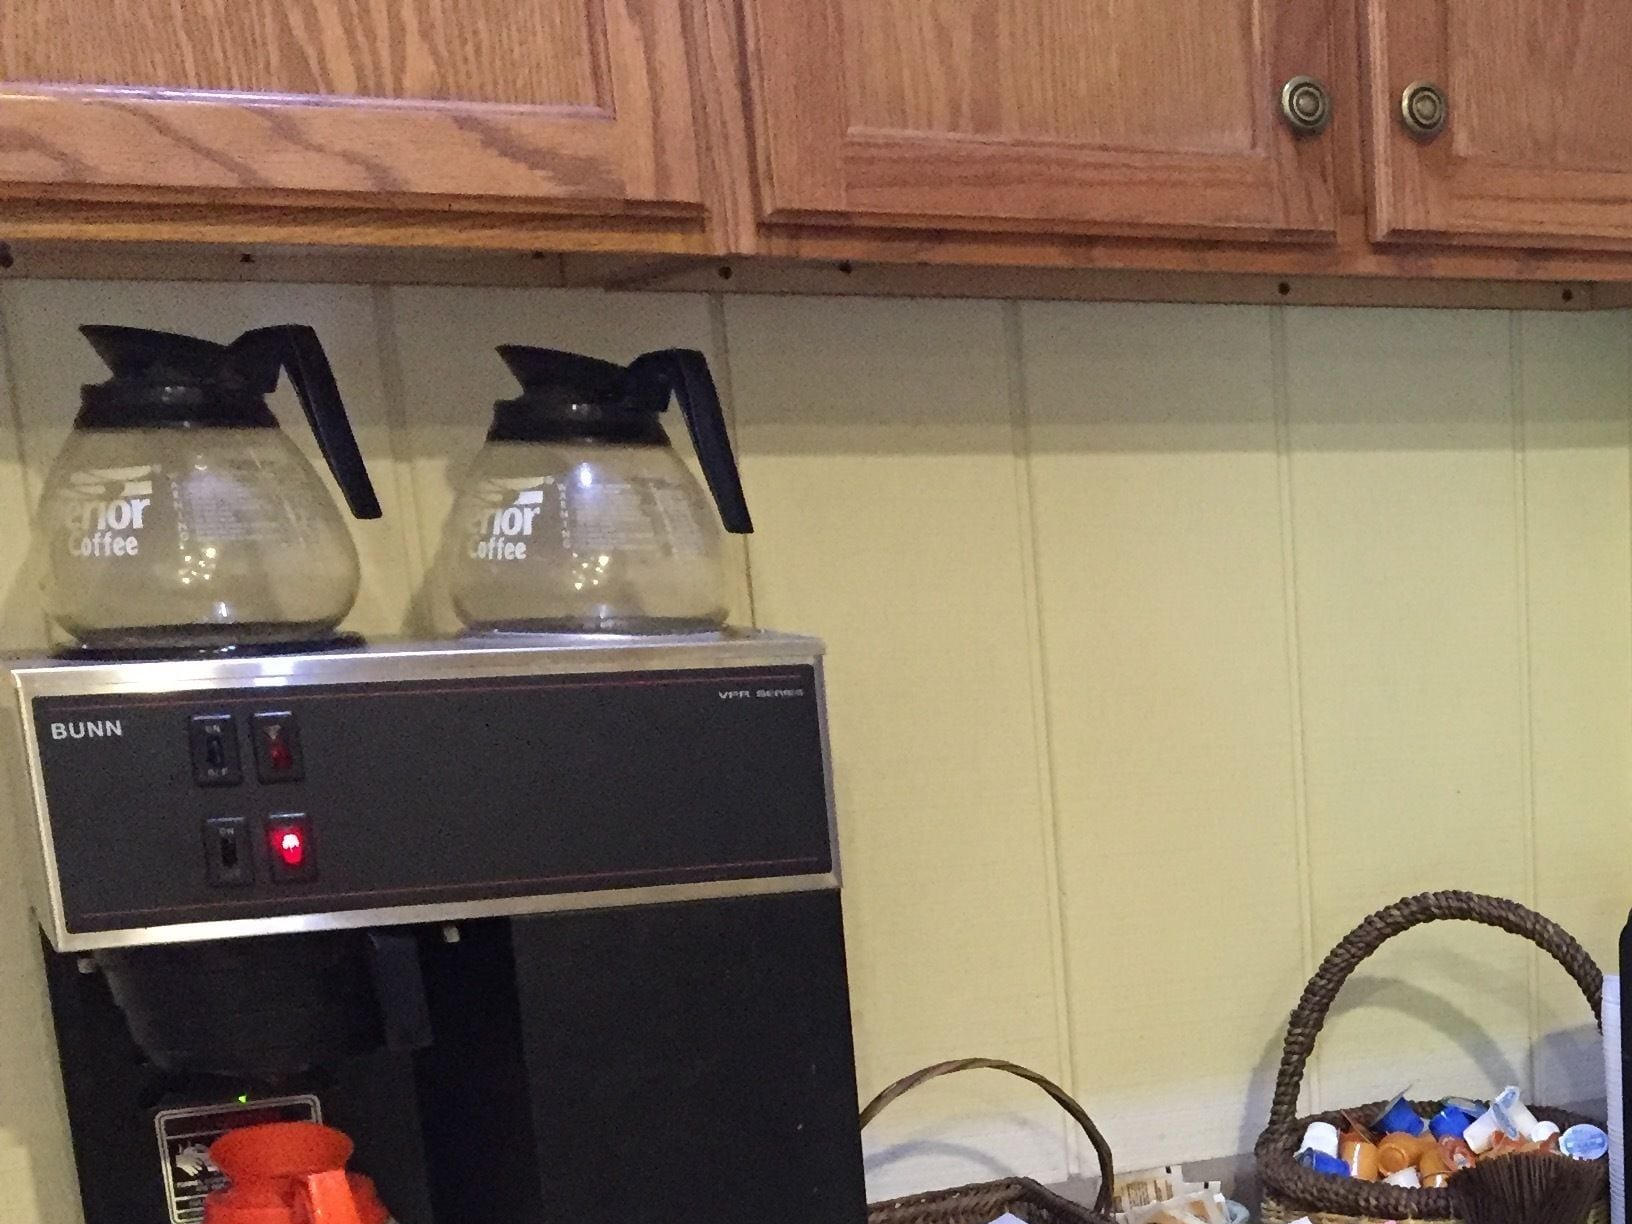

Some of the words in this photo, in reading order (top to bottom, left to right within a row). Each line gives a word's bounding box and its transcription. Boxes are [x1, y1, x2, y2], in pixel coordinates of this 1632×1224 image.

[69, 531, 138, 557] Coffee
[469, 536, 527, 560] Coffee
[51, 720, 123, 740] BUNN
